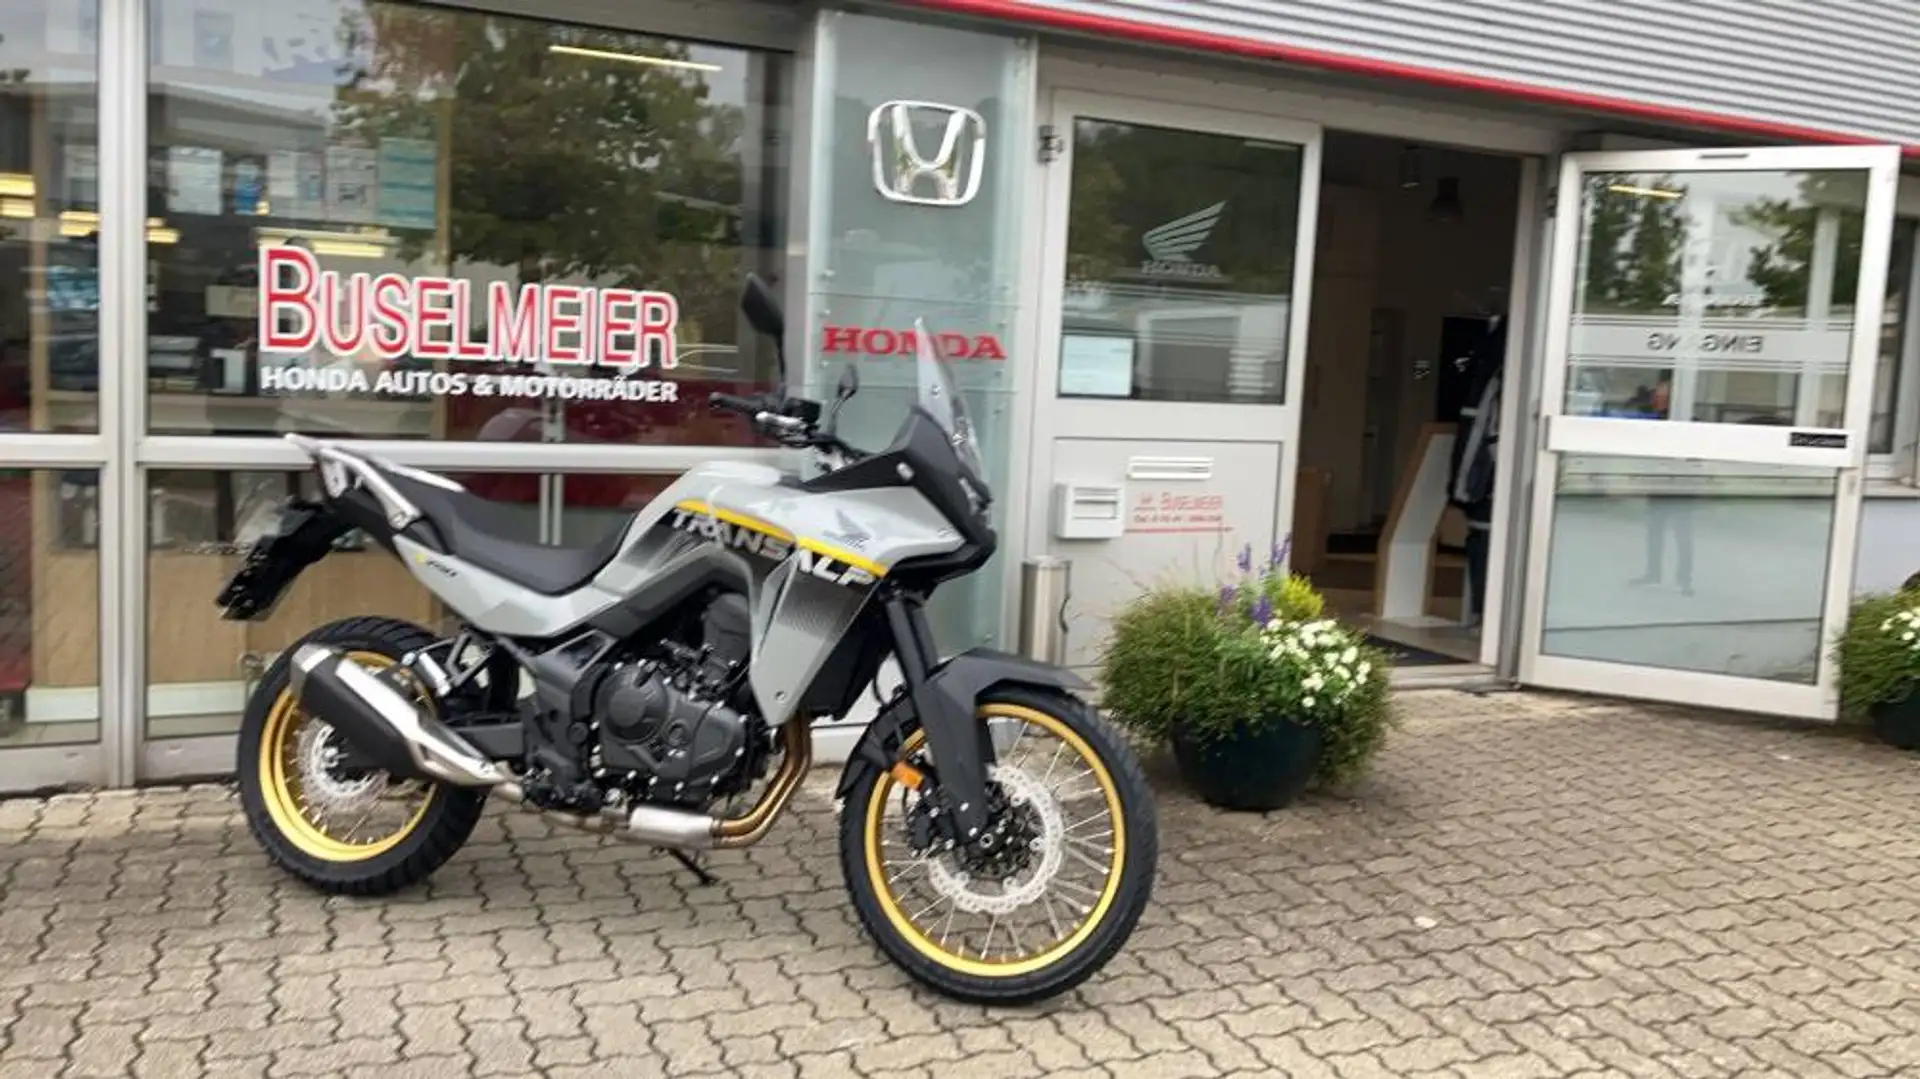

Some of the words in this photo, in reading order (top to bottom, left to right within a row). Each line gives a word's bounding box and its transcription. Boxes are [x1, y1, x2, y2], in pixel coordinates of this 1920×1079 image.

[1140, 259, 1222, 278] HONDA
[258, 245, 679, 369] BUSELMEIER
[260, 366, 367, 391] HONDA
[373, 371, 468, 396] AUTOS
[472, 375, 495, 397] &
[499, 373, 679, 402] MOTORRÄDER
